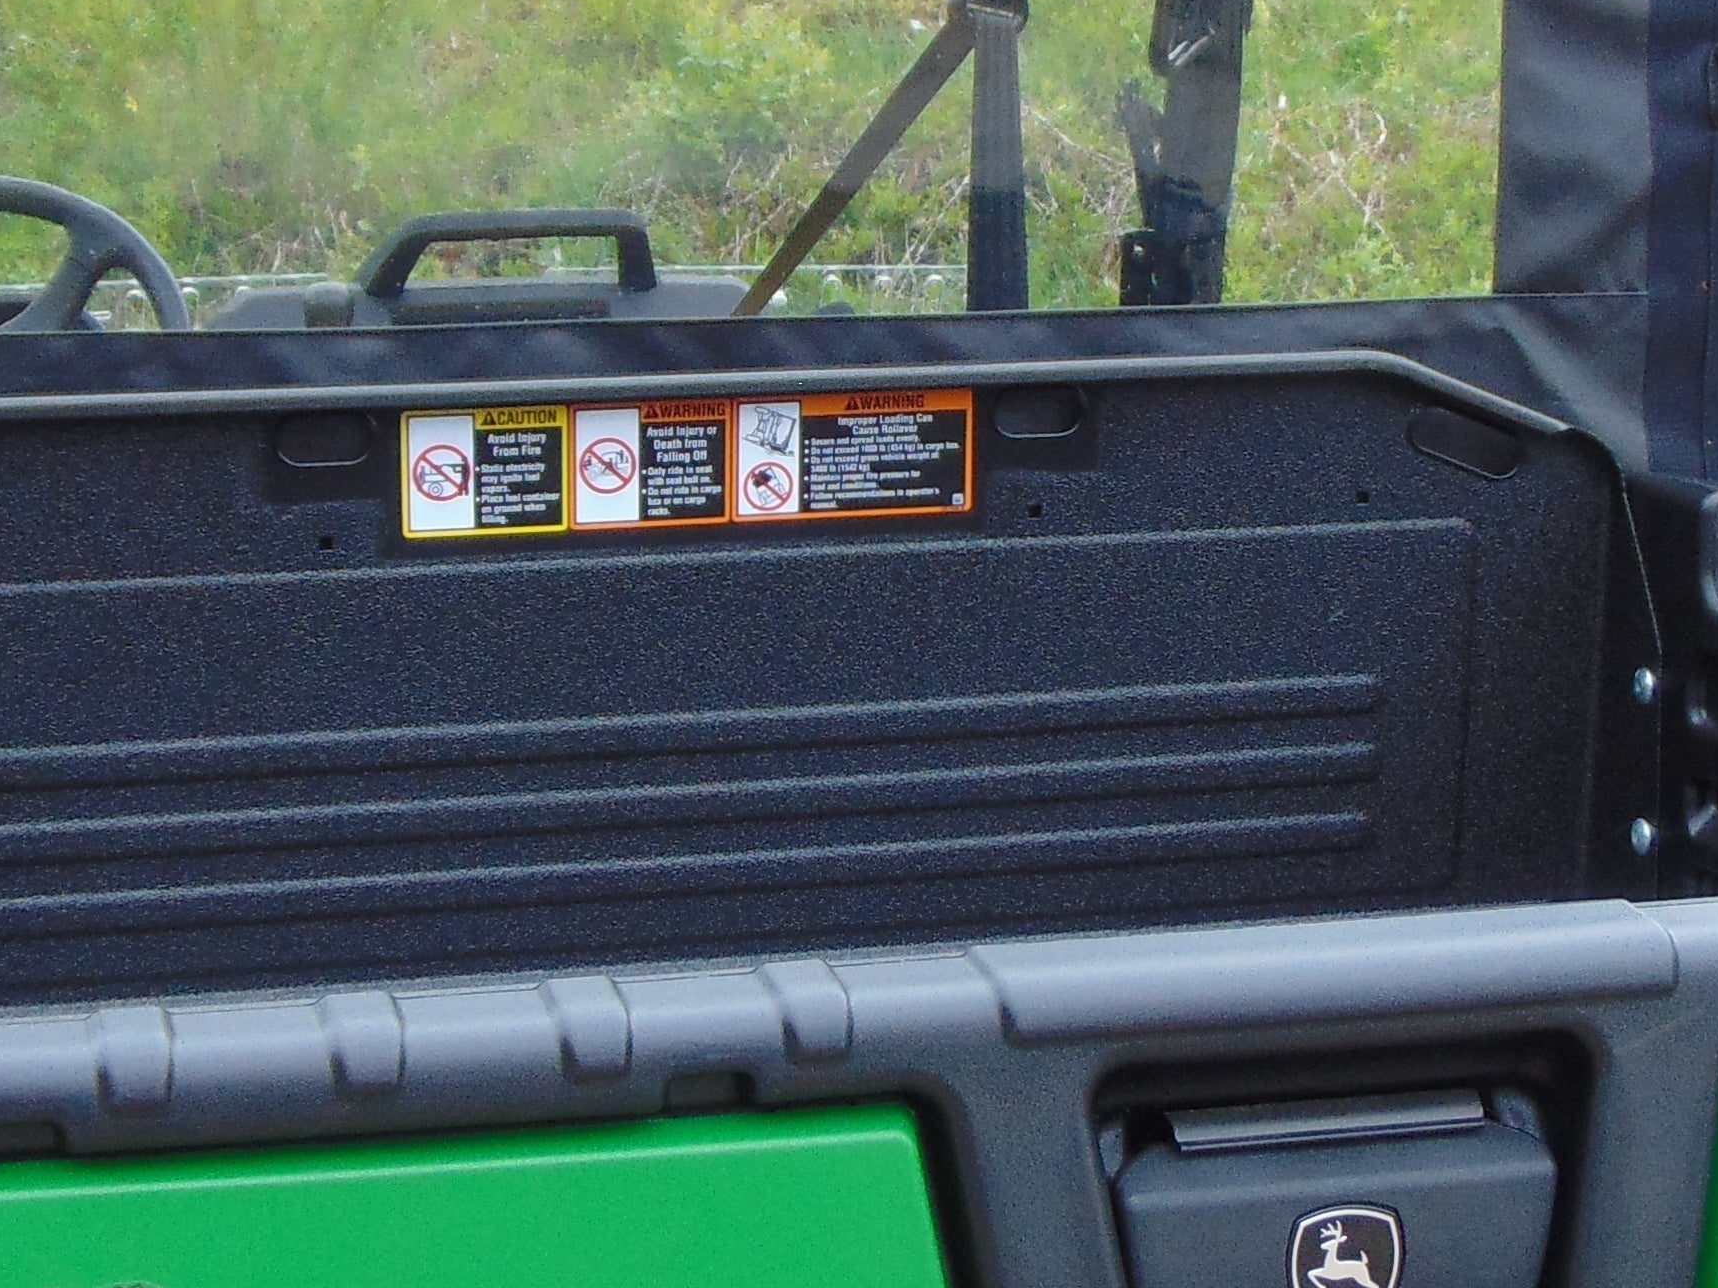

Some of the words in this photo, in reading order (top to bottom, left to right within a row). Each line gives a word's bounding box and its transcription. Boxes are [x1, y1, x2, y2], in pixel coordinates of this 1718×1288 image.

[860, 395, 924, 409] WARNING
[659, 404, 725, 418] WARNING
[498, 410, 557, 425] CAUTION
[837, 416, 878, 427] Improper
[879, 414, 914, 425] Loading
[916, 413, 933, 423] Can
[646, 426, 674, 437] Avoid
[677, 425, 704, 437] Injury
[706, 426, 717, 435] or
[853, 425, 879, 435] Cause
[882, 424, 918, 433] Rollover
[487, 432, 515, 444] Avoid
[518, 432, 547, 444] Injury
[653, 438, 682, 450] Death
[685, 439, 707, 448] from
[493, 445, 519, 457] From
[521, 444, 542, 456] Fire
[656, 451, 690, 463] Falling
[693, 450, 708, 461] Off
[648, 466, 666, 477] Only
[667, 465, 683, 475] ride
[648, 486, 659, 495] Do
